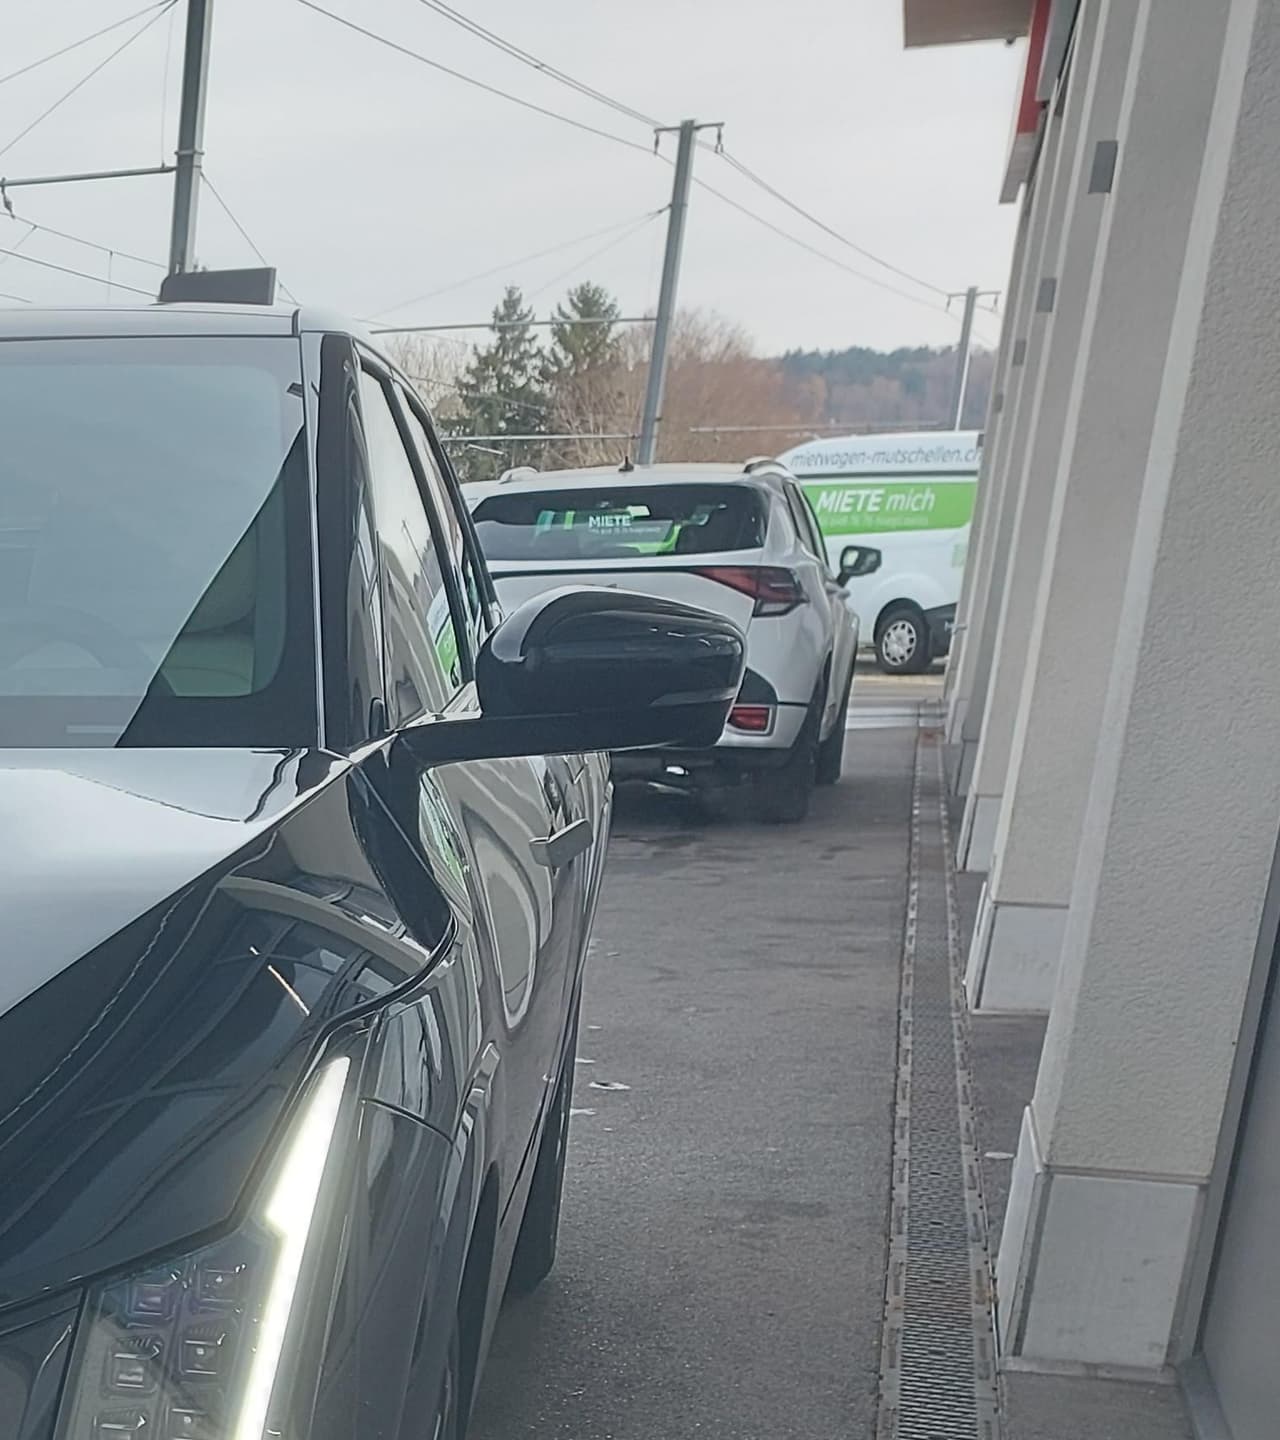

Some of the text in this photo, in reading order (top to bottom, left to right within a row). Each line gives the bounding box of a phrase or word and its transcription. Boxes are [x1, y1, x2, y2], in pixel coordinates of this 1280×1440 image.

[817, 487, 935, 513] MIETE mich
[588, 515, 631, 528] MIETE
